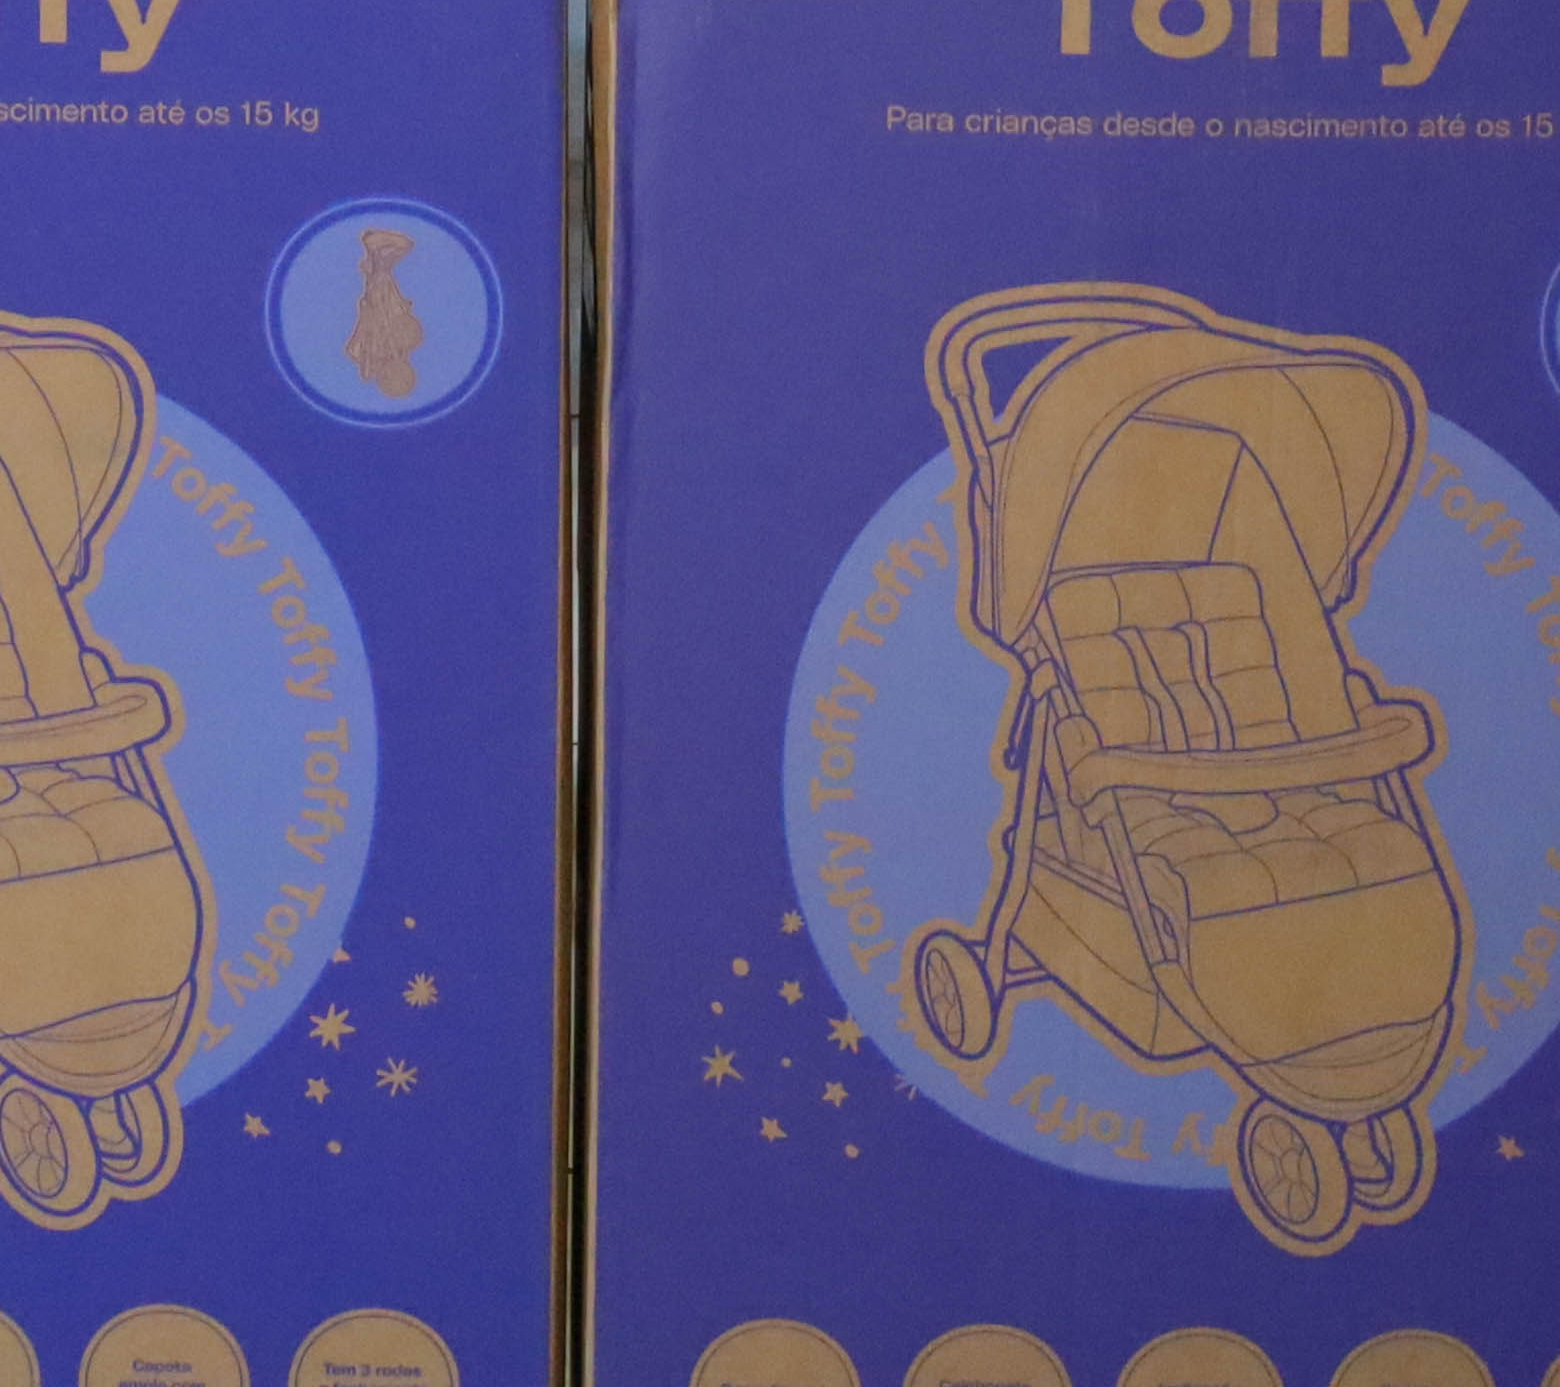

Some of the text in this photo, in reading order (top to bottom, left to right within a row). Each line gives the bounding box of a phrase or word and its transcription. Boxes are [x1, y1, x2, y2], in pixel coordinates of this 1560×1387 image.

[138, 94, 186, 128] até
[194, 104, 233, 128] os
[241, 102, 274, 129] 15
[282, 102, 320, 134] kg
[885, 103, 957, 134] Para
[965, 104, 1094, 143] crianças
[1103, 109, 1196, 138] desde
[1205, 117, 1225, 139] o
[1234, 110, 1410, 140] nascimento
[1418, 109, 1468, 142] até
[1475, 118, 1513, 142] os
[1519, 115, 1555, 143] 15
[151, 437, 268, 561] Toffy
[1421, 452, 1535, 576] Toffy
[258, 560, 335, 703] Toffy
[842, 520, 952, 648] Toffy
[287, 718, 350, 864] Toffy
[812, 661, 877, 811] Toffy
[220, 879, 327, 1007] Toffy
[818, 825, 898, 972] Toffy
[1010, 1074, 1152, 1161] Toffy
[323, 1361, 422, 1378] Tem 3 rodas
